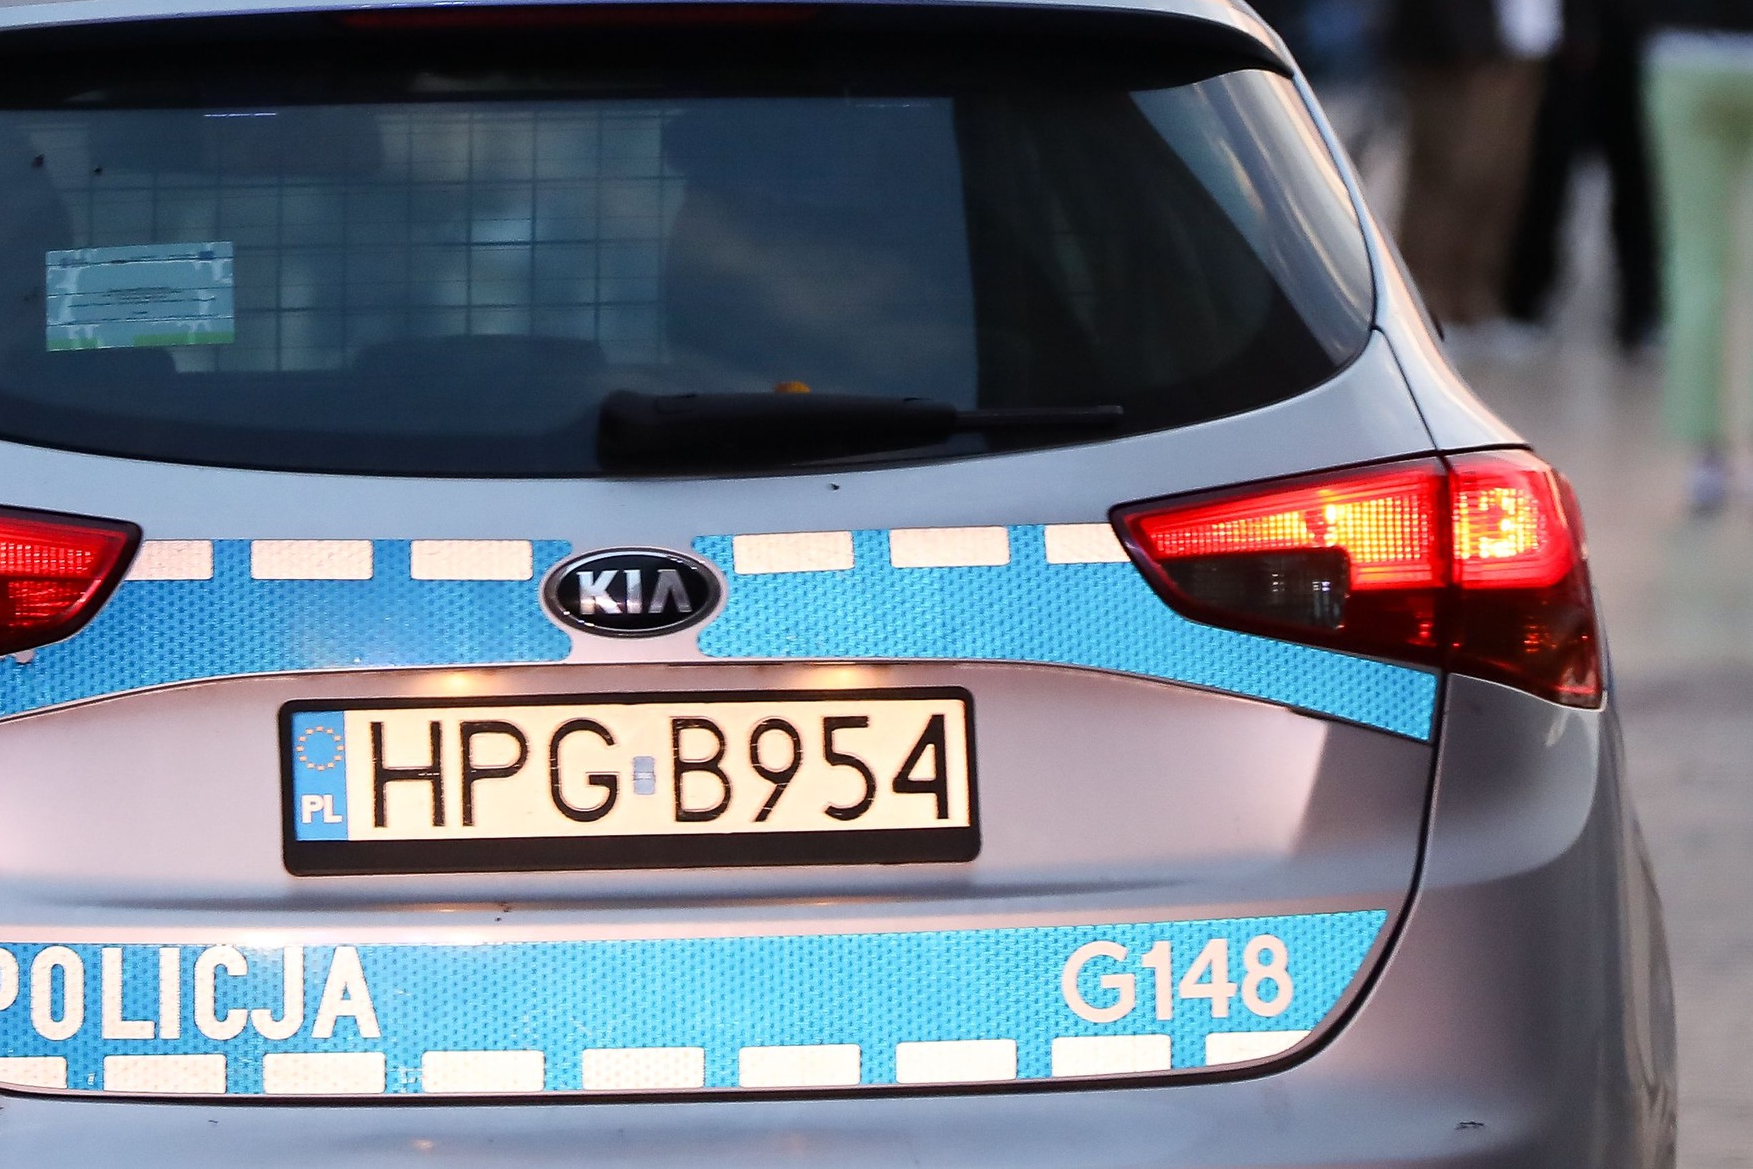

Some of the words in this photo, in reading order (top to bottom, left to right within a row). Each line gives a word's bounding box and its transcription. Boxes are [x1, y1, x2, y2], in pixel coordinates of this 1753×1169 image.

[577, 568, 693, 616] KIA
[369, 716, 620, 828] HPG
[670, 713, 951, 824] B954
[301, 794, 343, 824] PL
[1060, 933, 1295, 1024] G148
